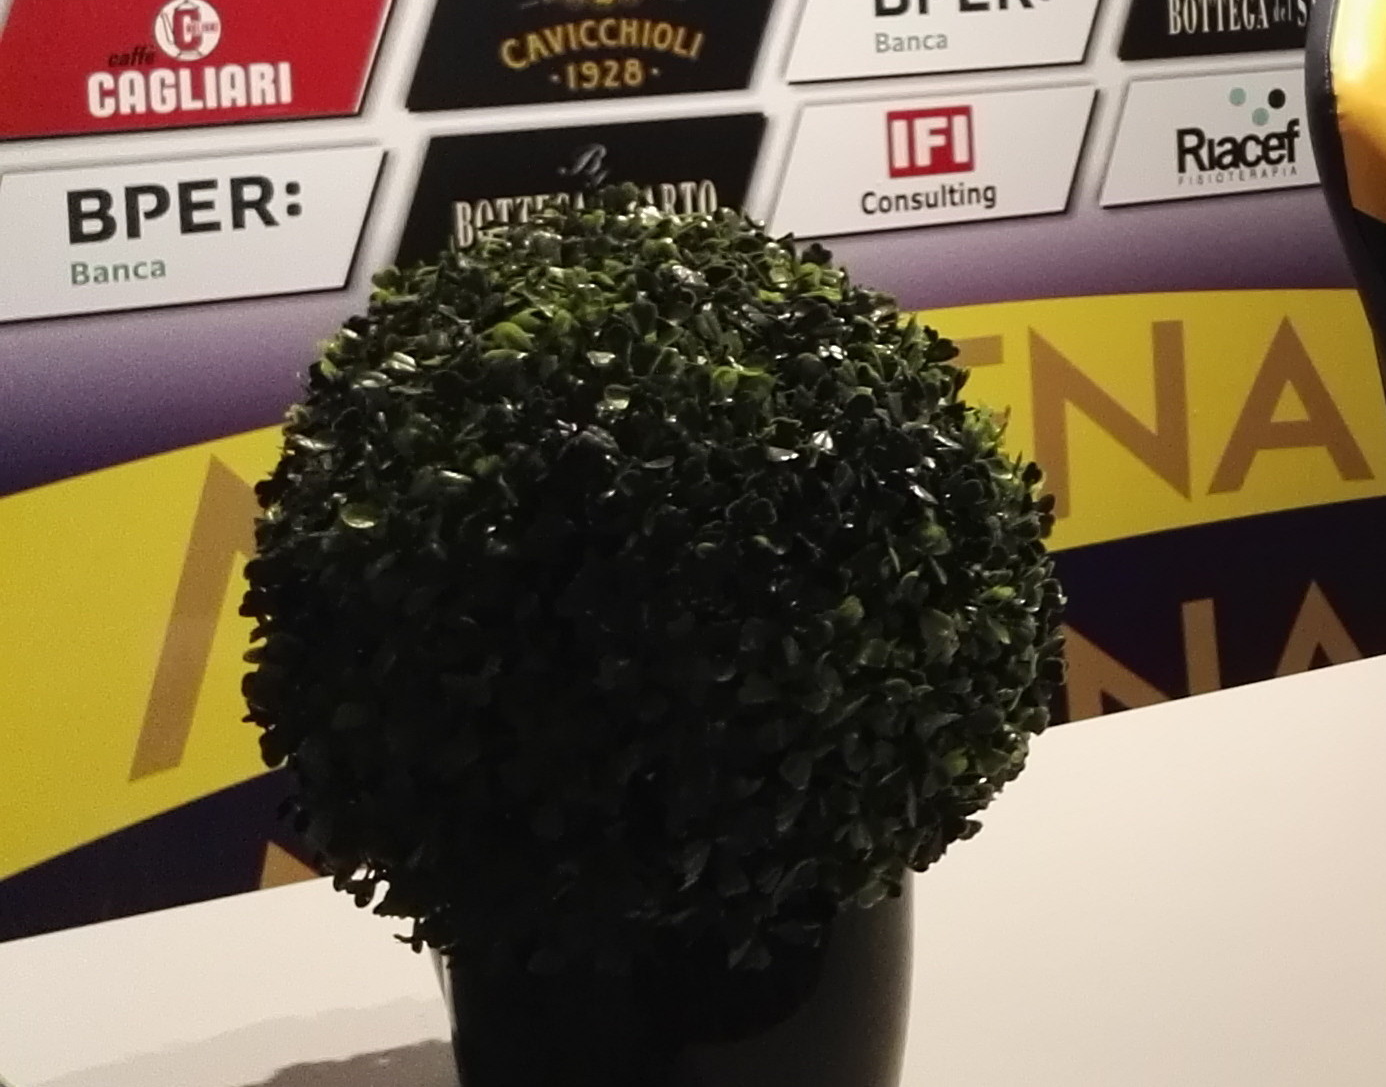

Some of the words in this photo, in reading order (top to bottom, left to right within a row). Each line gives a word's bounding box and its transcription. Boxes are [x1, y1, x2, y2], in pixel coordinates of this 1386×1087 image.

[1273, 0, 1292, 24] del
[875, 32, 948, 54] Banca
[88, 62, 292, 117] CAGLIARI
[890, 117, 972, 172] IFI
[1176, 119, 1300, 175] Riacef
[1178, 166, 1299, 186] FISIOTERAPIA
[66, 174, 302, 246] BPER:
[861, 182, 997, 216] Consulting
[70, 258, 167, 286] Banca
